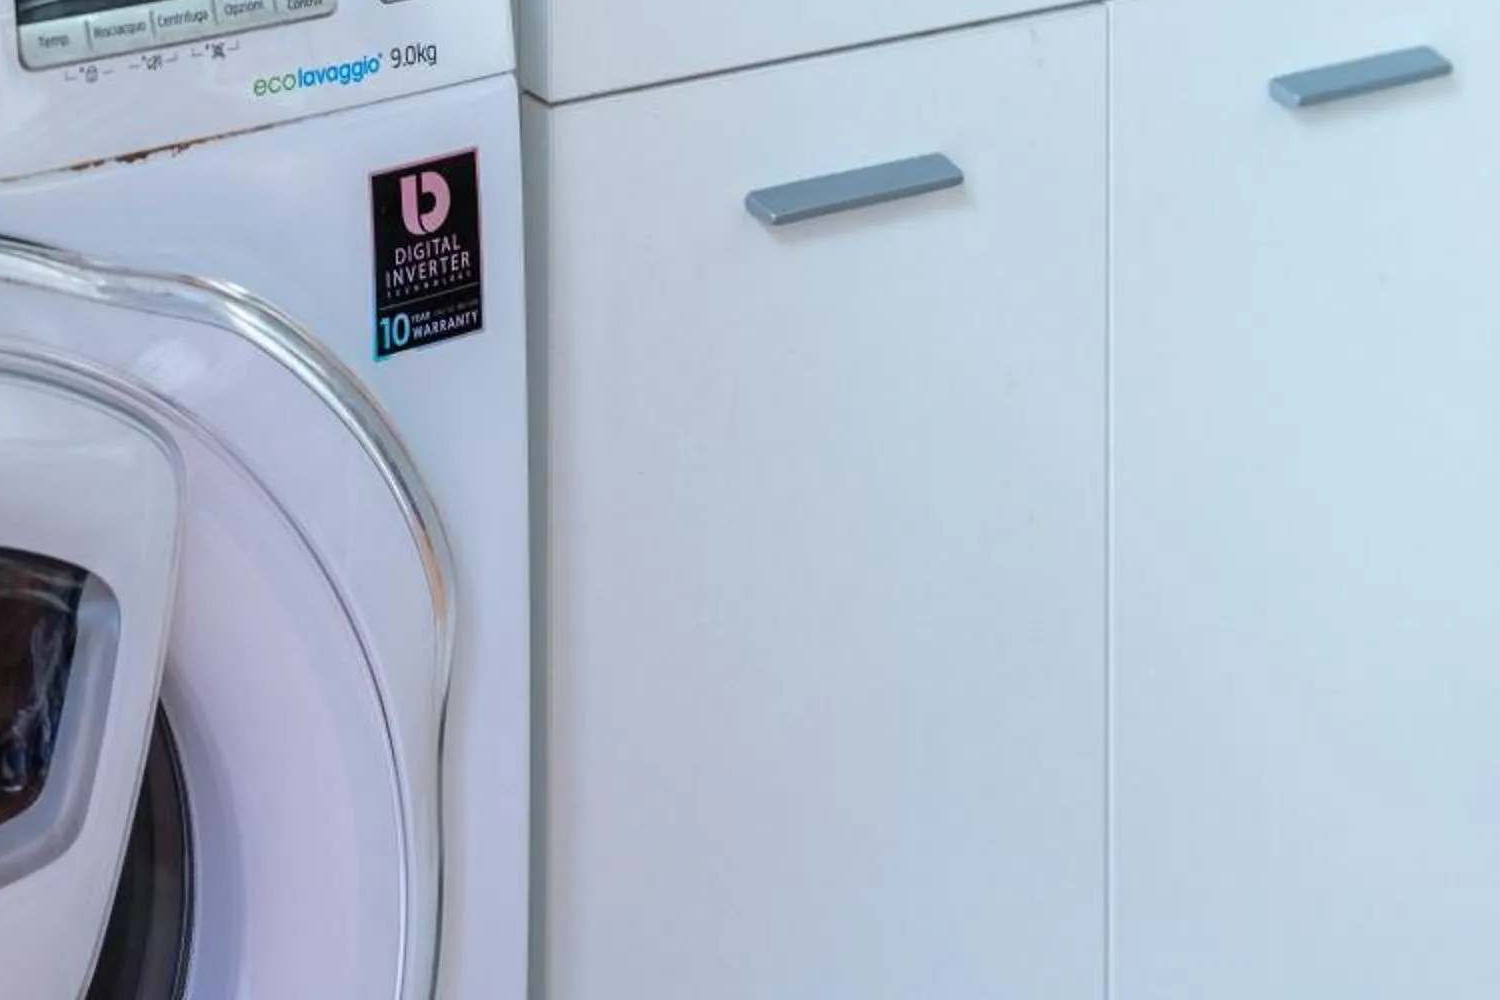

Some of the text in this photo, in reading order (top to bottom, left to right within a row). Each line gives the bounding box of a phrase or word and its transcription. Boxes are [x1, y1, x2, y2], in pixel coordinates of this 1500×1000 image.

[389, 43, 438, 70] 9.0kg
[395, 234, 461, 266] DIGITAL
[386, 251, 471, 289] INVERTER
[380, 312, 411, 350] 10
[412, 311, 479, 339] WARRANTY
